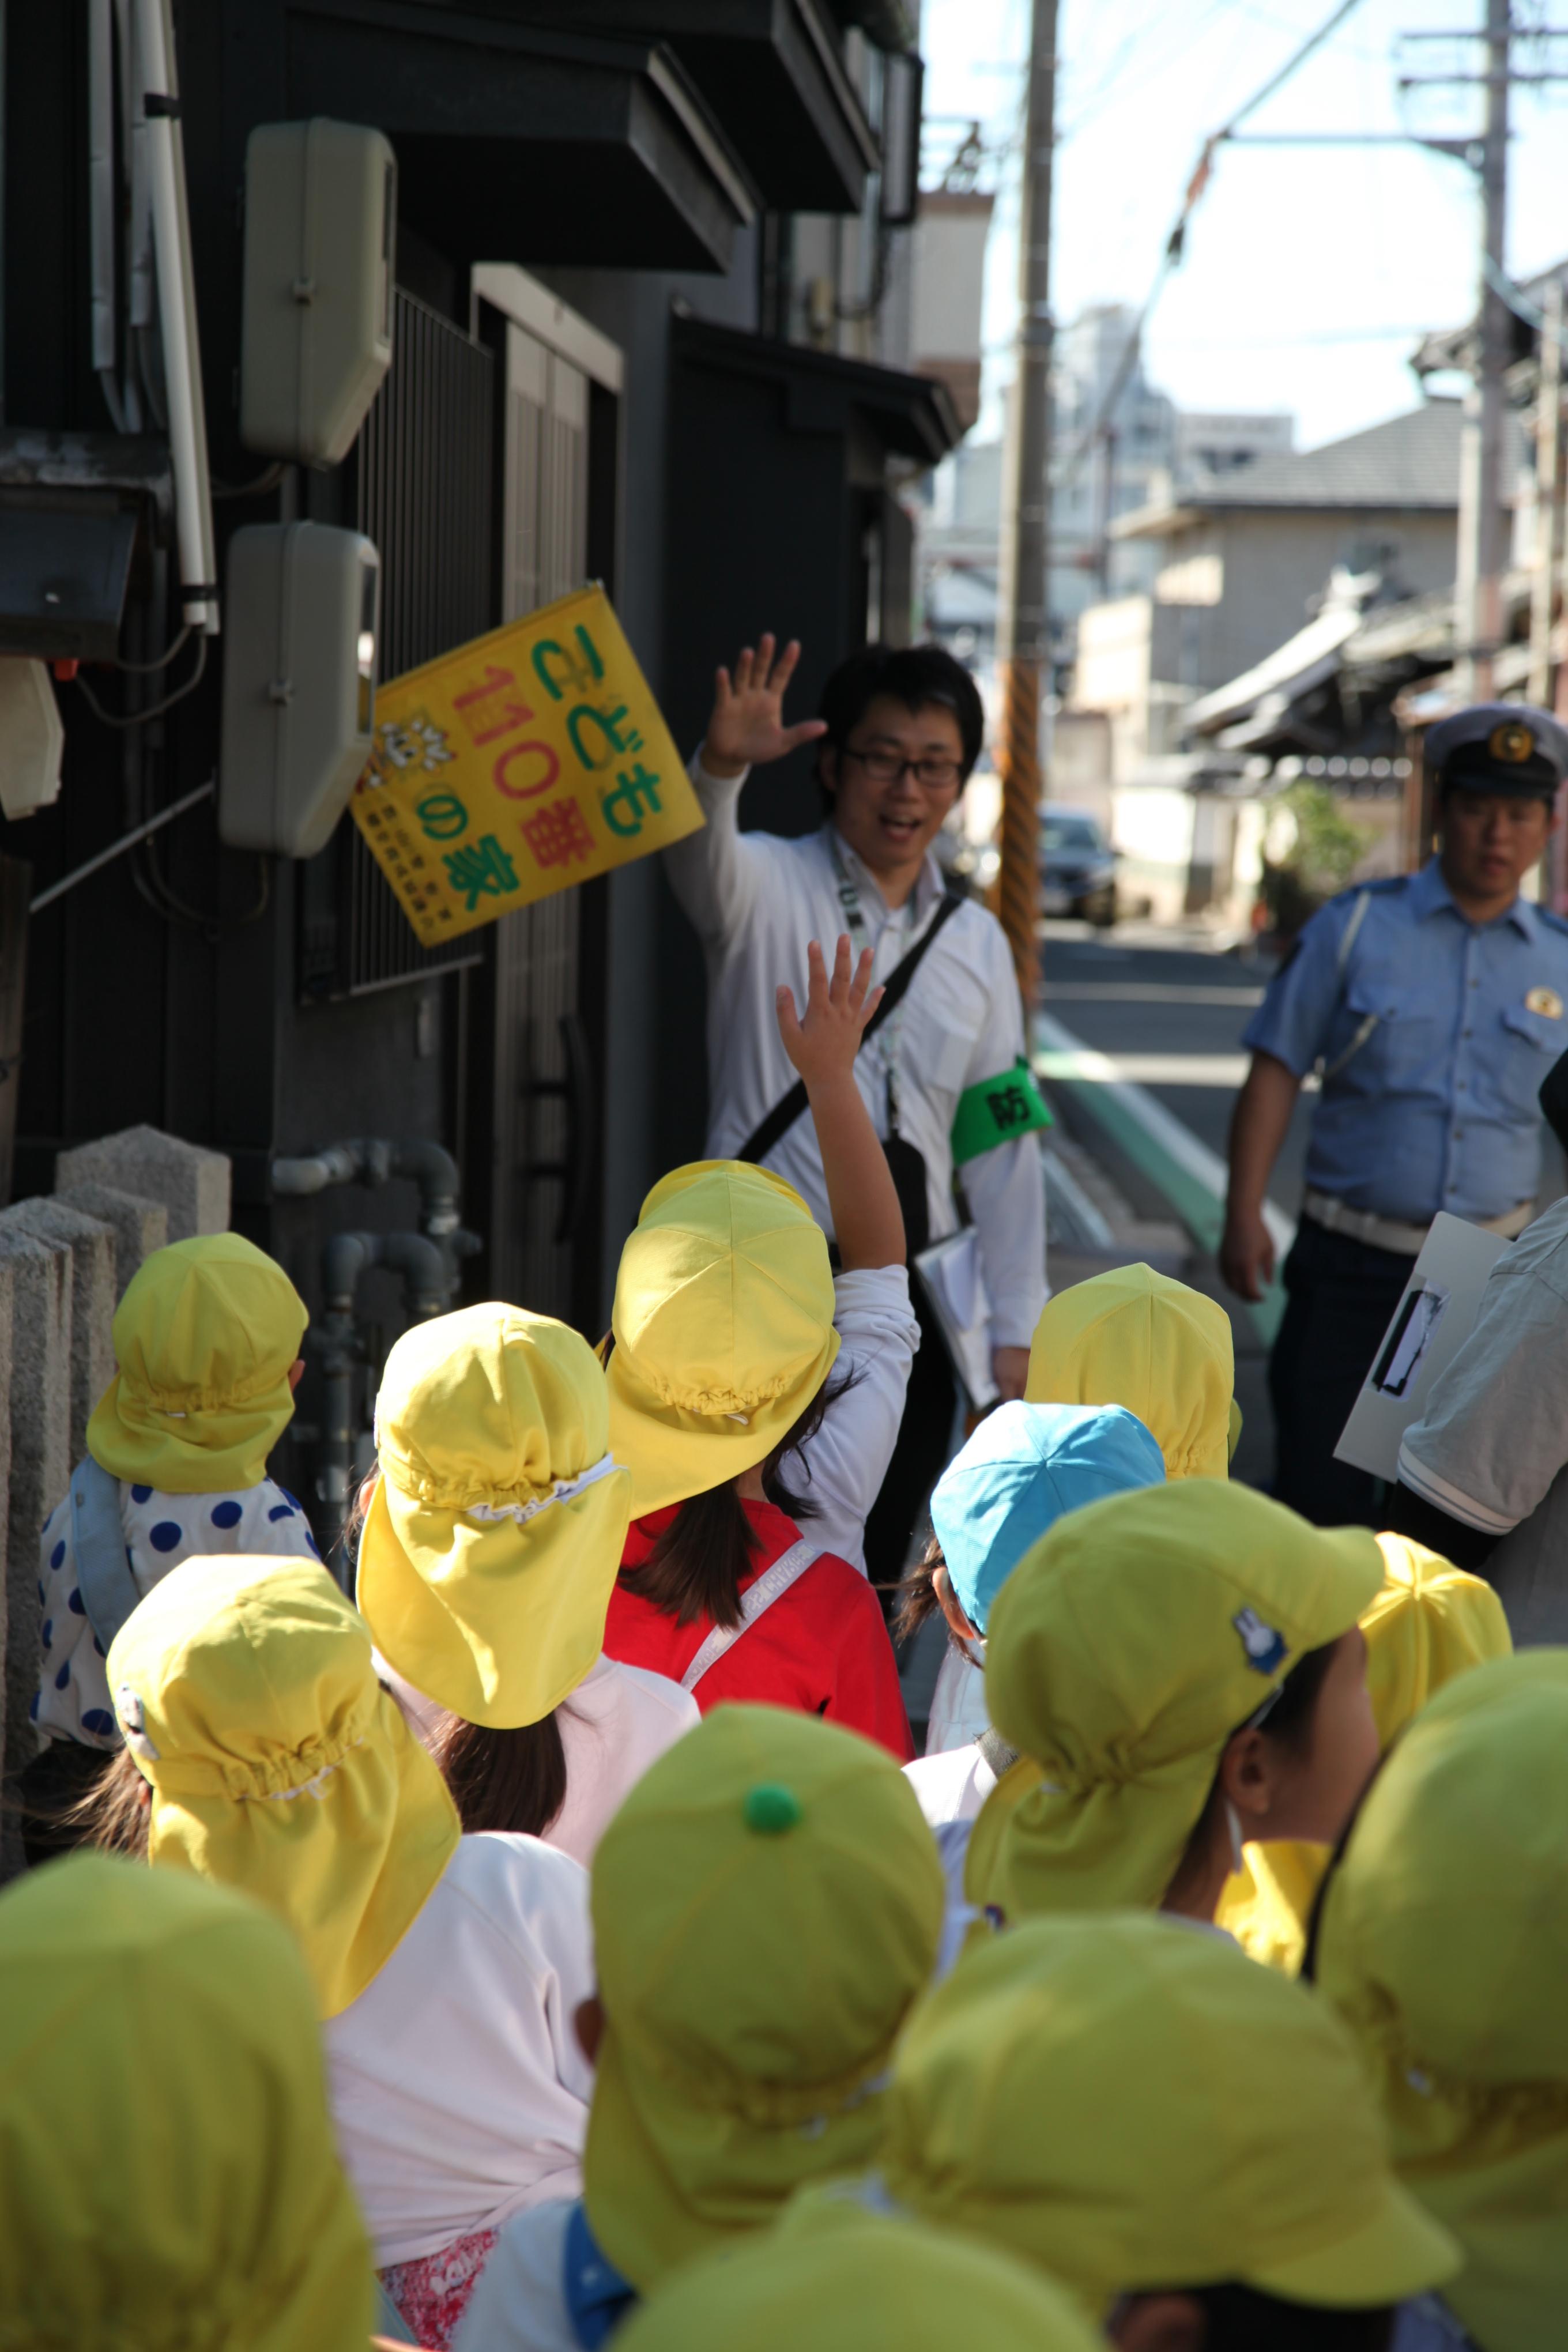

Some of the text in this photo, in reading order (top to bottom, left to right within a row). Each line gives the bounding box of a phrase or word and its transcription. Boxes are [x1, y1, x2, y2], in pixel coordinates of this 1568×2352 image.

[453, 665, 596, 870] 110番
[531, 624, 661, 838] こども
[416, 794, 521, 911] の家
[985, 1085, 1031, 1132] 防
